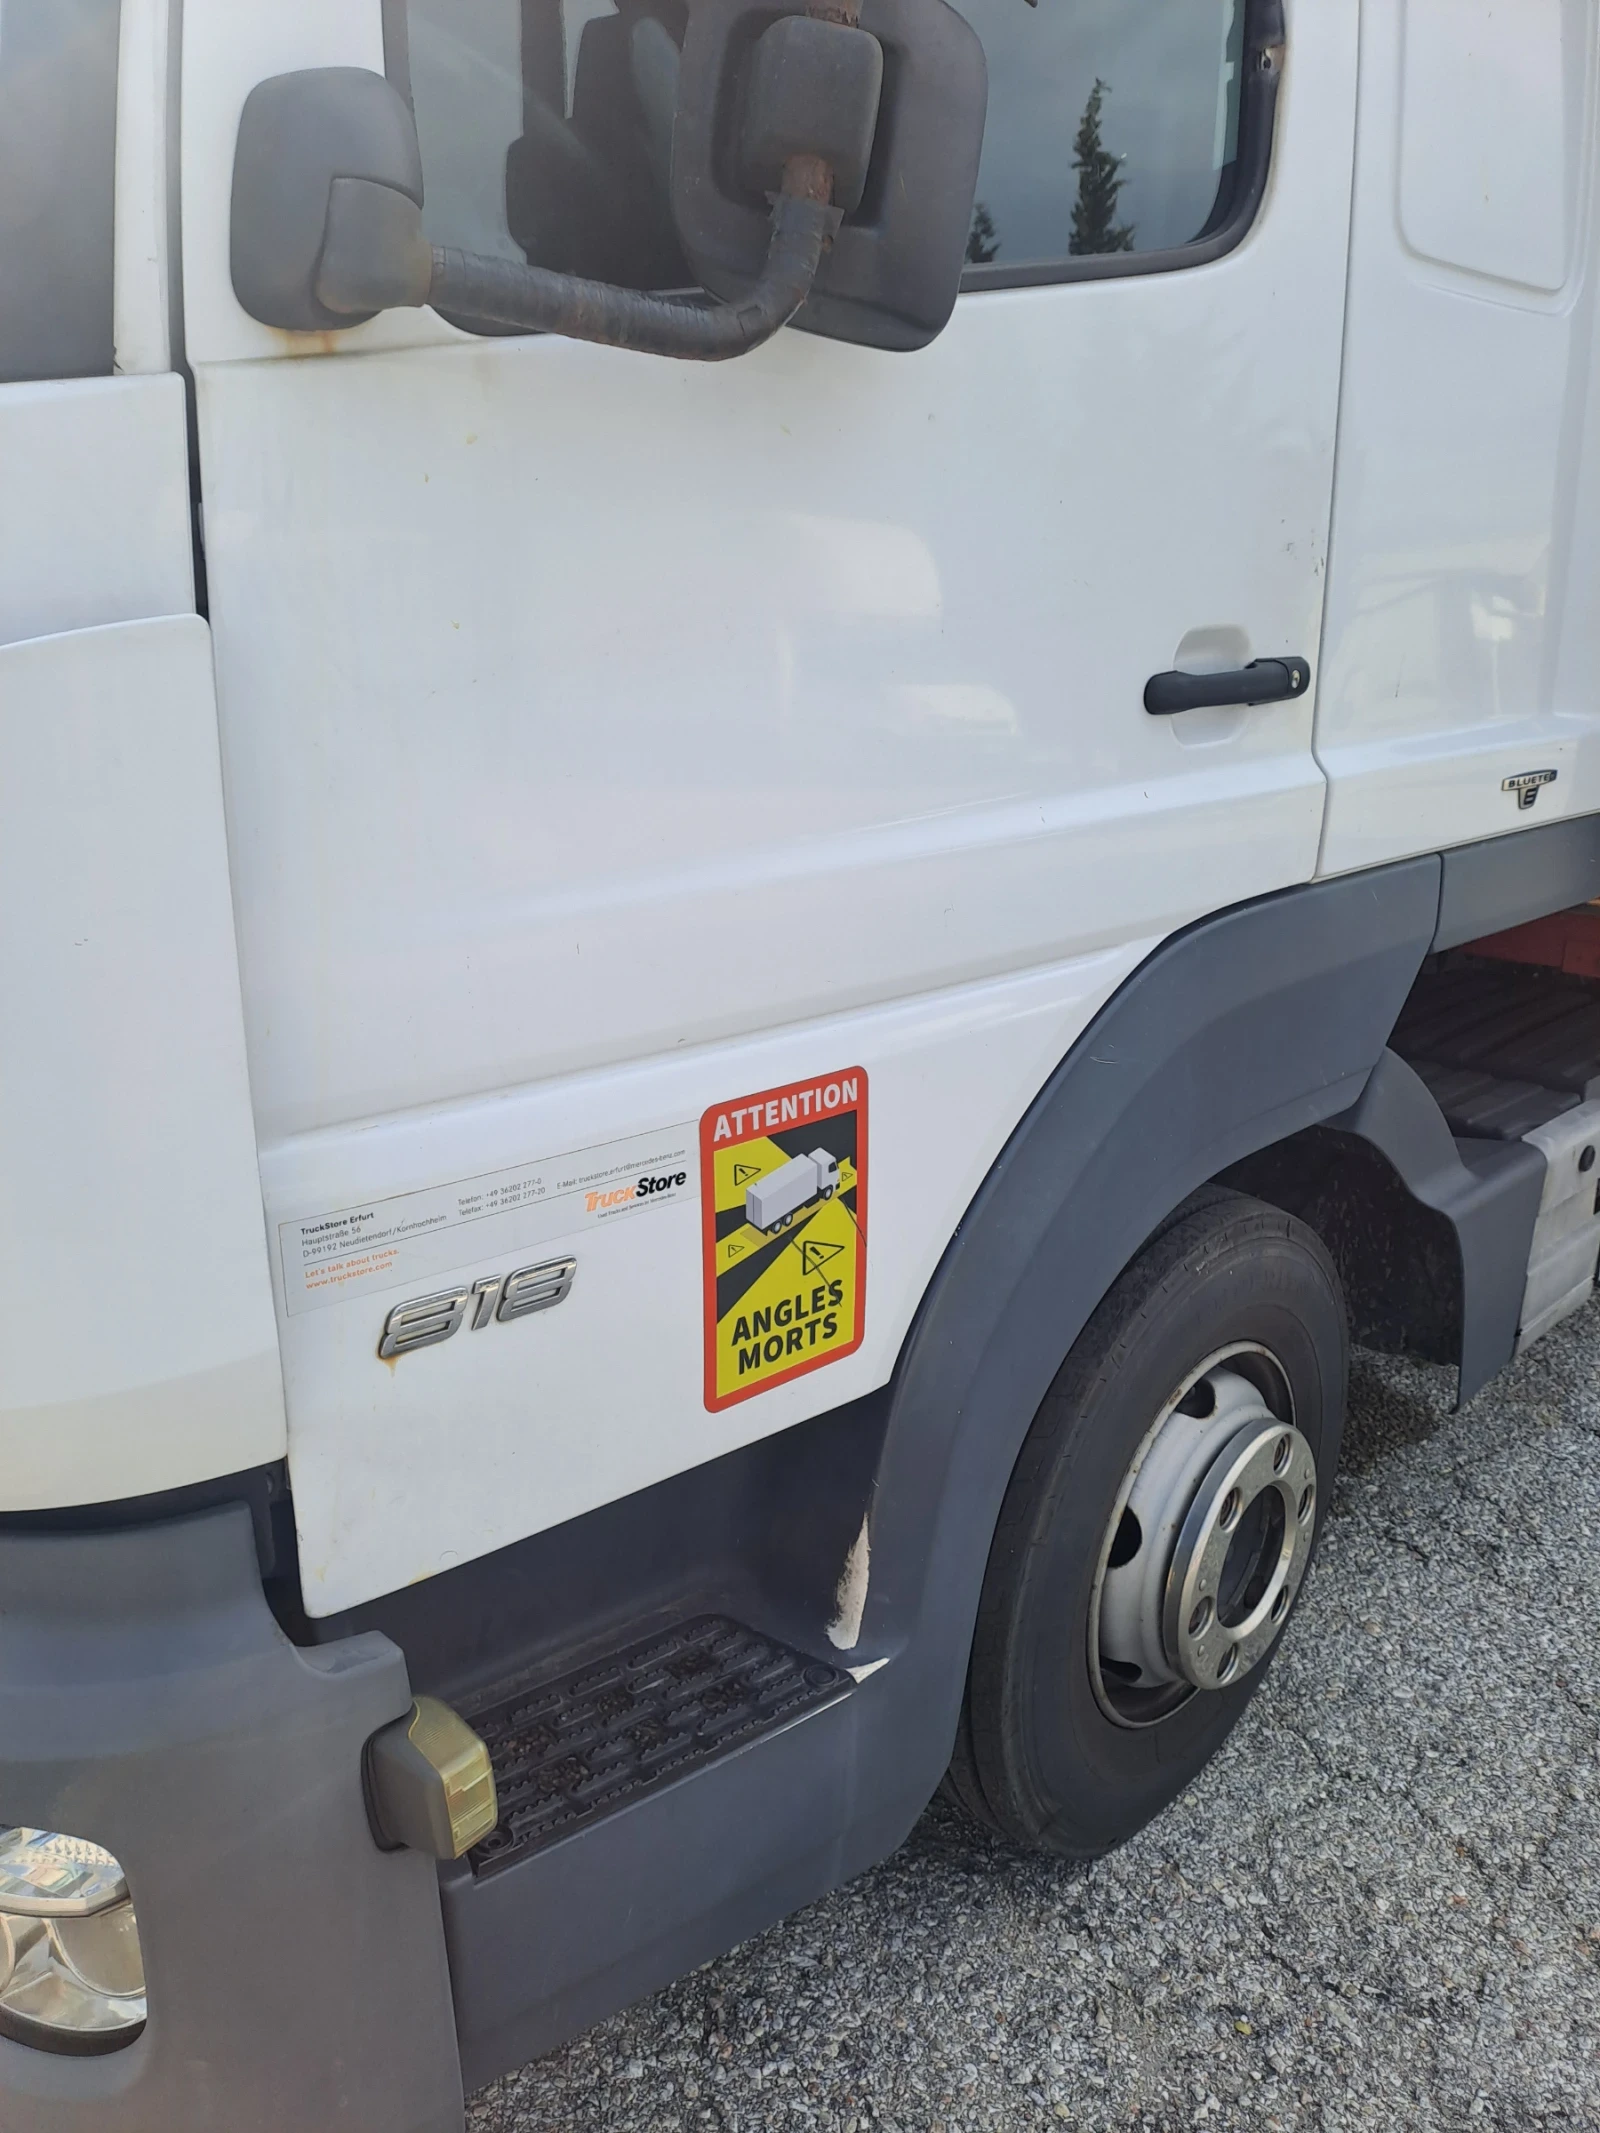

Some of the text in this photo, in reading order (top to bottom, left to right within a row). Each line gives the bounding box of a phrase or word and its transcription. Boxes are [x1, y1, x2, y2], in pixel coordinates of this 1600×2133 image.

[713, 1077, 858, 1142] ATTENTION
[458, 1177, 542, 1206] Telefon: +49 36202 277-0
[556, 1179, 578, 1190] E-Mail:
[585, 1171, 687, 1213] TruckStore
[459, 1187, 546, 1216] Telefax: +49 36202 277-20
[301, 1212, 375, 1236] TruckStore Erfurt
[301, 1226, 361, 1247] Hauptstraße 56
[303, 1214, 447, 1258] D-99192 Neudietendorf/Kornhochheim
[305, 1249, 400, 1279] Let's talk about trucks.
[306, 1261, 393, 1290] www.truckstore.com
[378, 1254, 578, 1359] 818
[731, 1279, 844, 1347] ANGLES
[738, 1311, 838, 1376] MORTS
